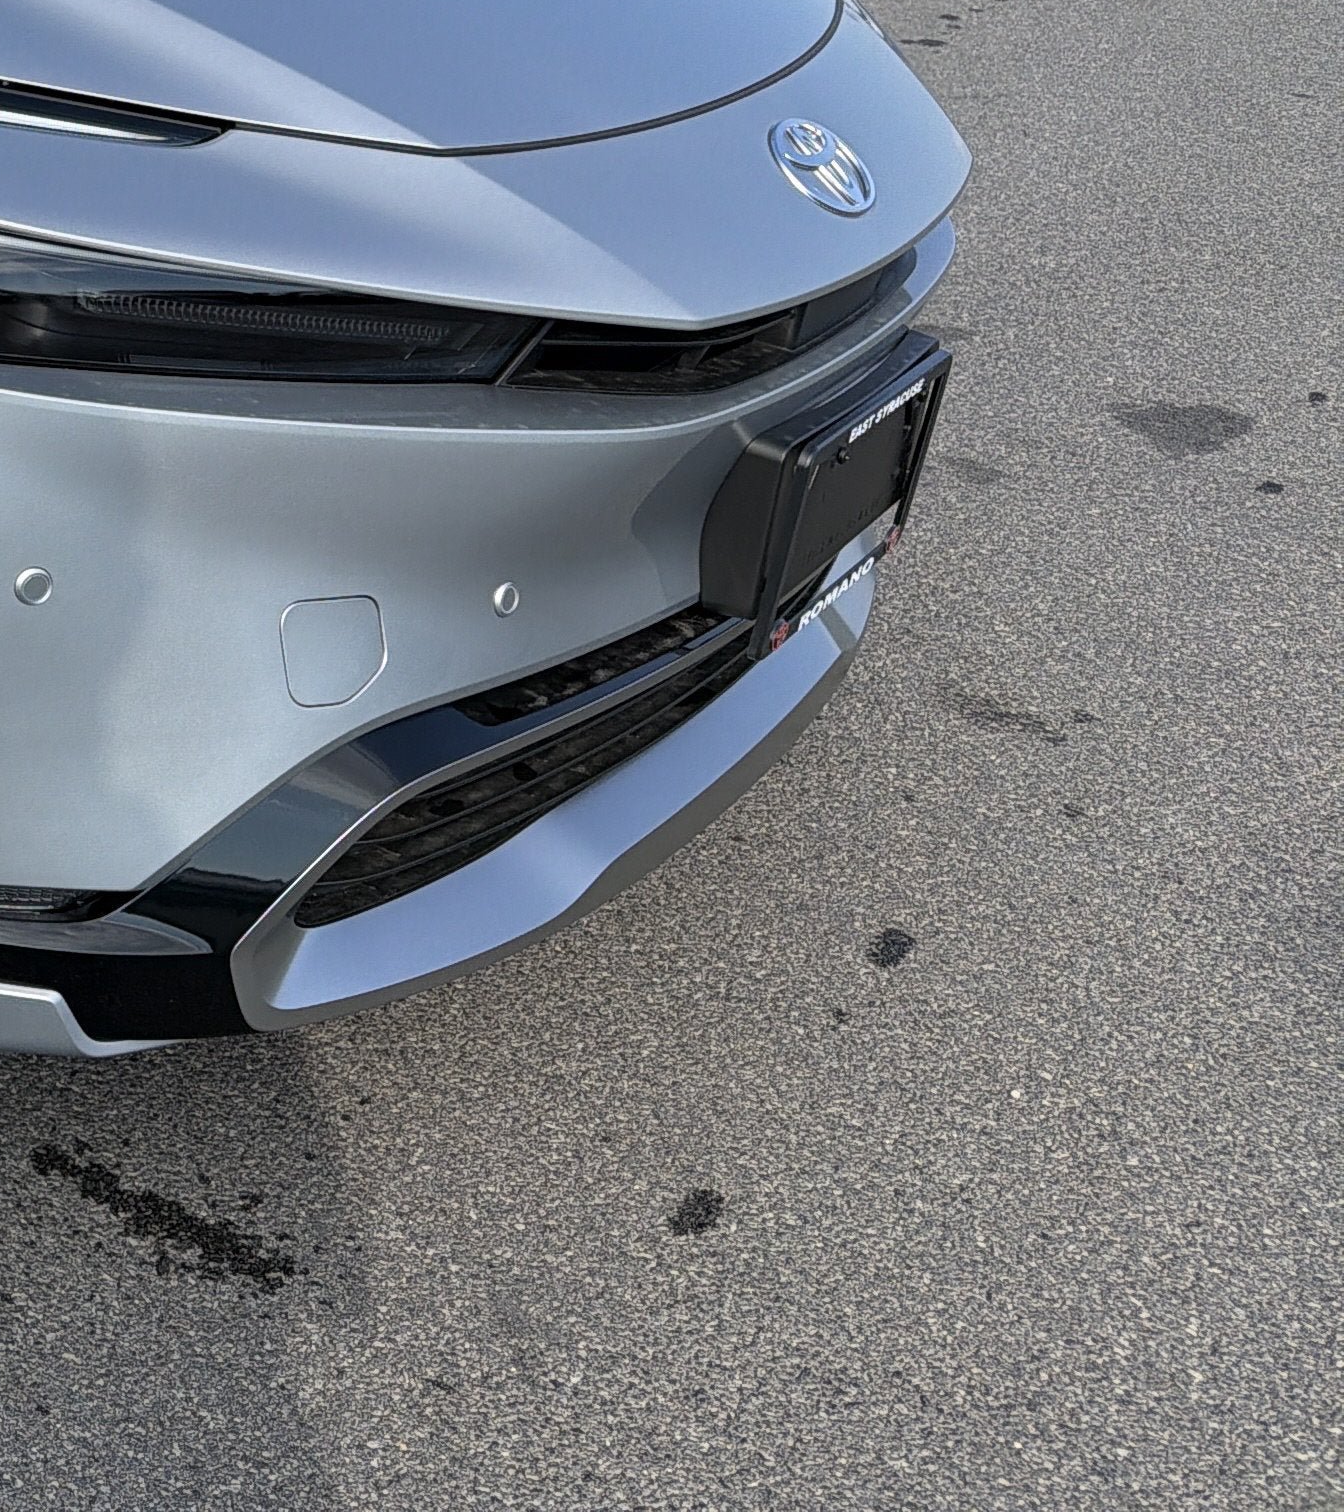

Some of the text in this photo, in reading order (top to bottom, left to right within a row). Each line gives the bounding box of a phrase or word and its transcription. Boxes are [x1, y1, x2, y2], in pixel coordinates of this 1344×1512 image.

[848, 377, 926, 444] EAST SYRACUSE
[797, 556, 875, 632] ROMANO
